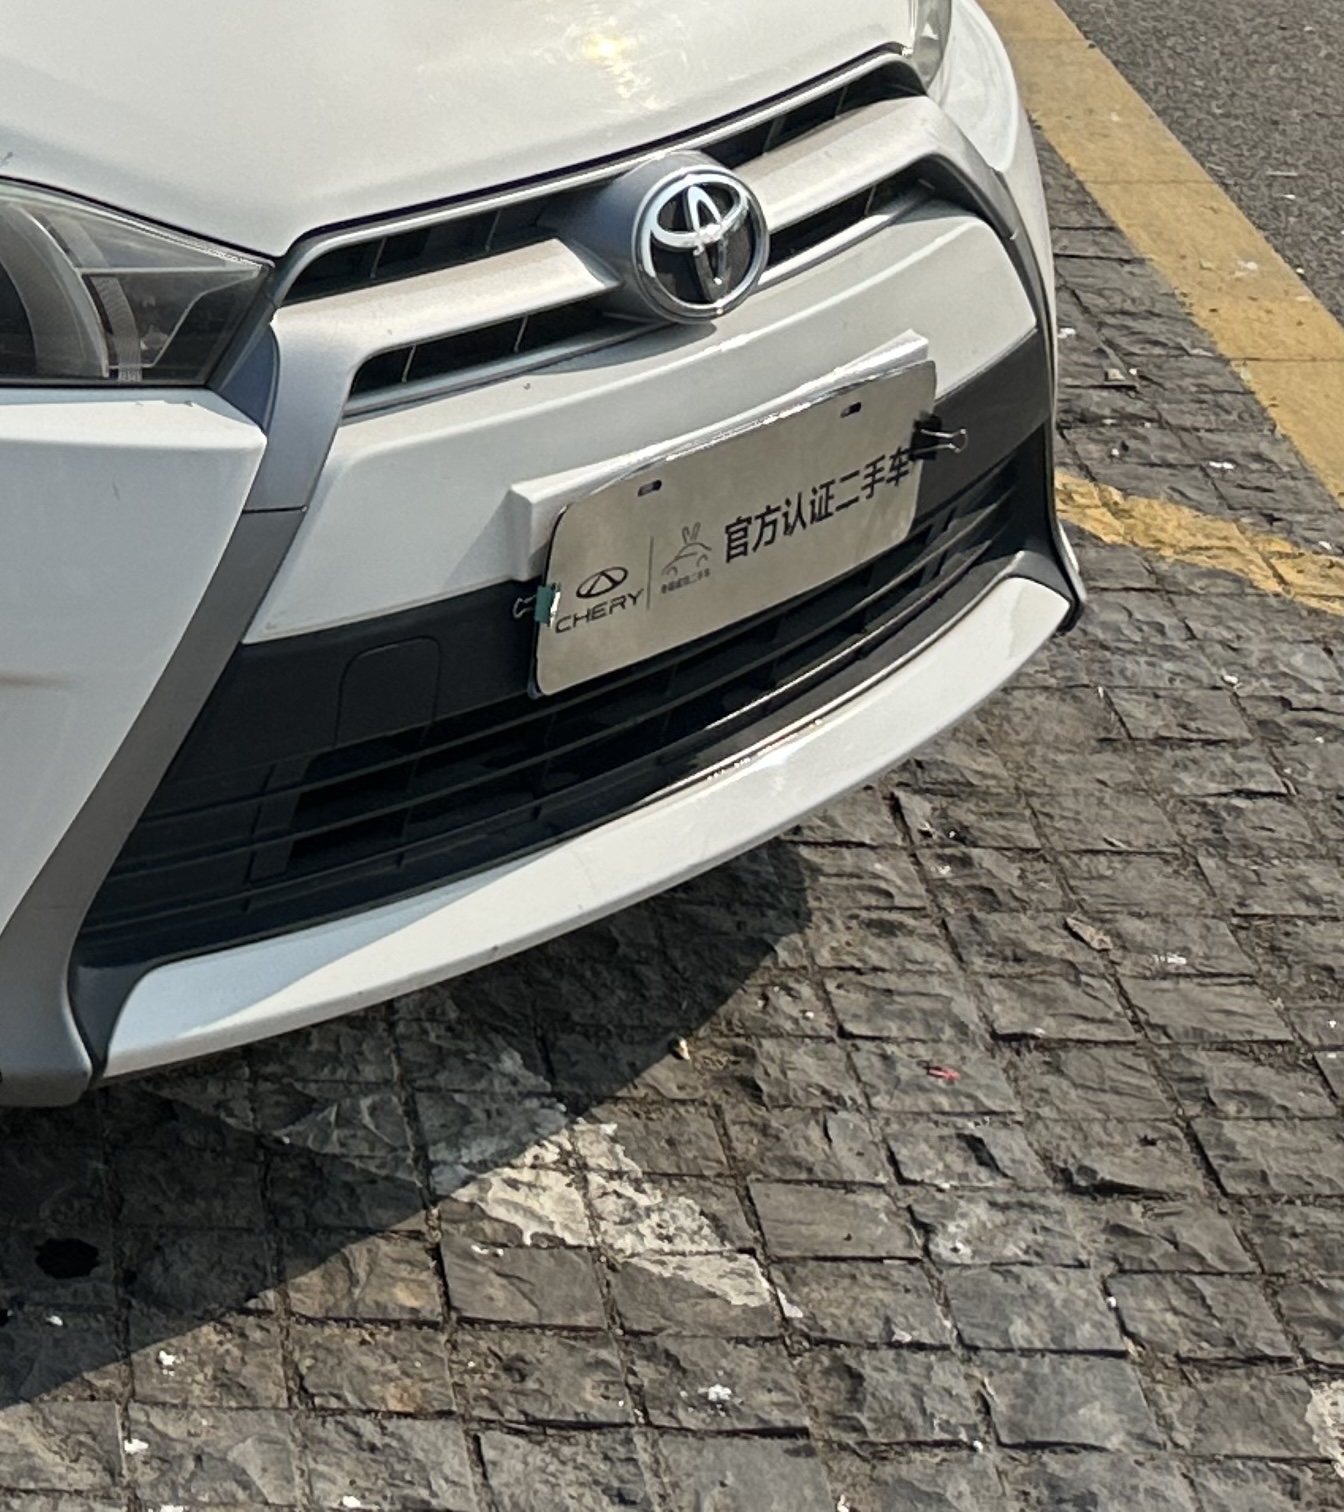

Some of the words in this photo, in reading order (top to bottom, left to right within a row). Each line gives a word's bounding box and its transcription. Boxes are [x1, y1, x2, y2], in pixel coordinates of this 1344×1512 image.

[724, 446, 912, 563] 官方认证二手车
[555, 588, 644, 634] CHERY
